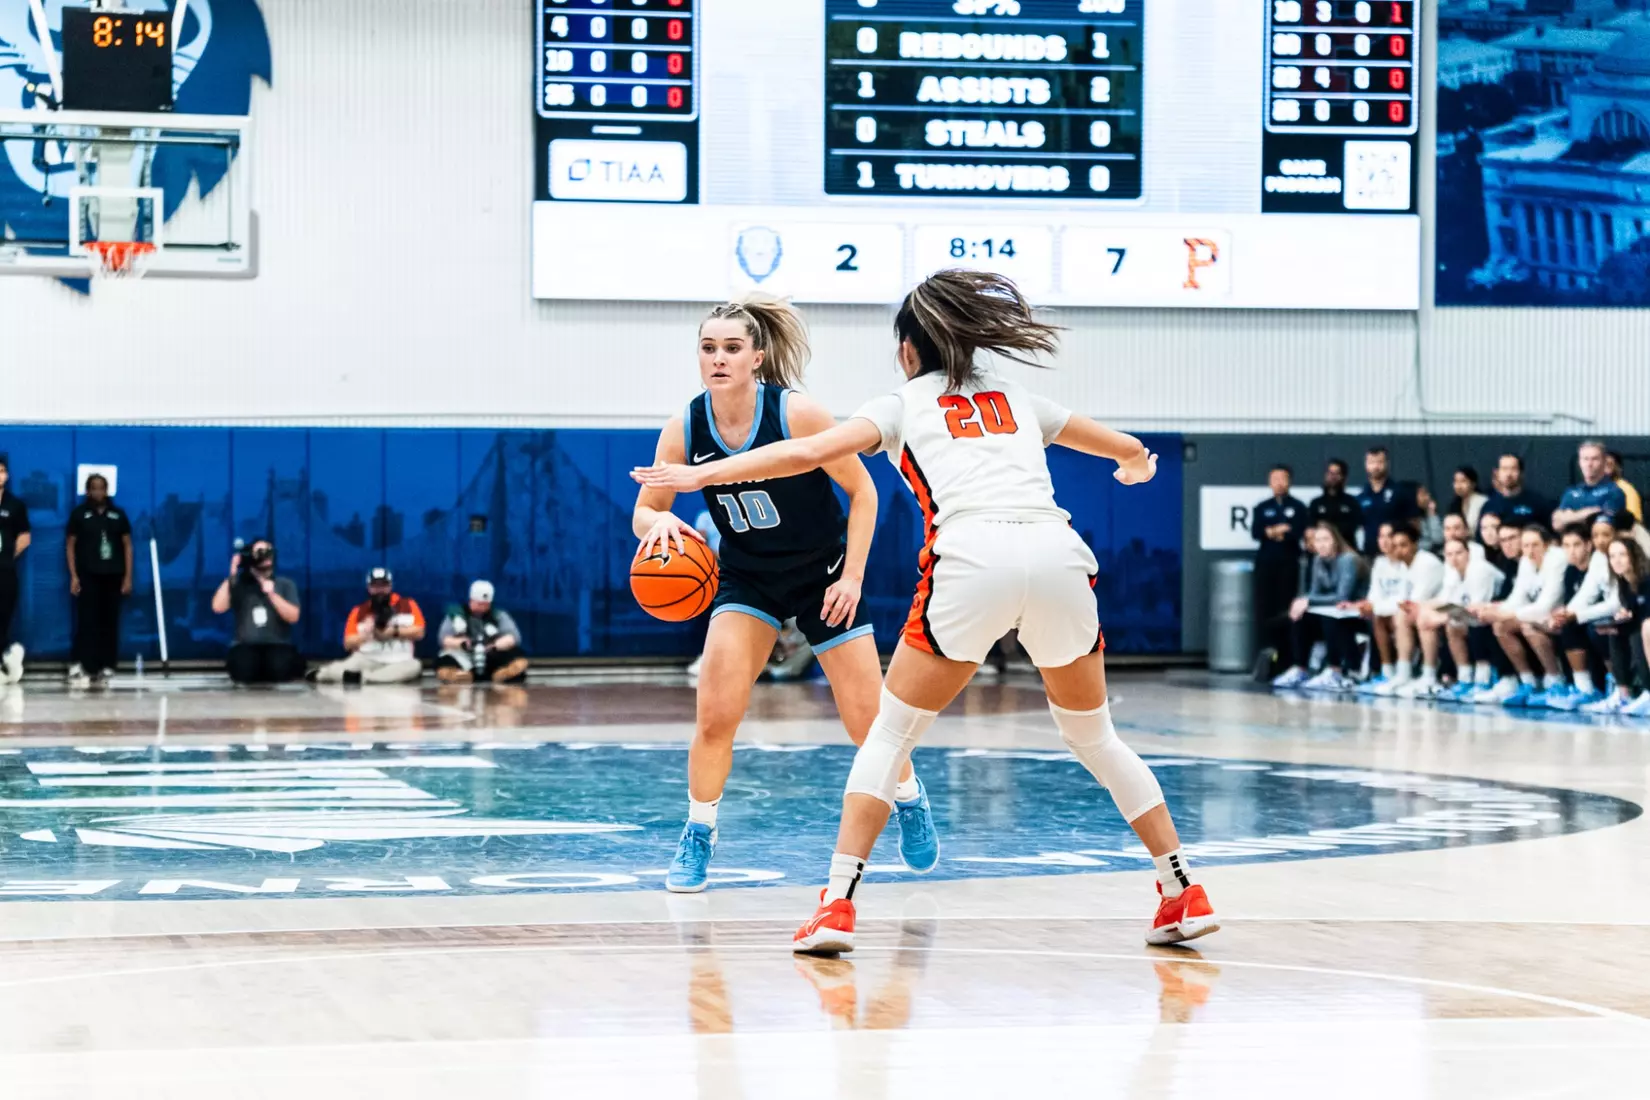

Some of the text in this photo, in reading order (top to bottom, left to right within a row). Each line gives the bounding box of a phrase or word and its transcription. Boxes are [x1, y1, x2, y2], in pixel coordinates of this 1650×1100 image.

[94, 17, 164, 47] 8:14
[591, 17, 605, 38] 0
[632, 19, 647, 38] 0
[668, 20, 682, 39] 0
[857, 28, 1109, 61] 0 REBOUNDS 1
[1390, 36, 1404, 56] 0
[591, 51, 605, 71] 0
[632, 53, 646, 73] 0
[668, 54, 682, 73] 0
[859, 72, 1109, 104] 1 ASSISTS 2
[1390, 69, 1404, 88] 0
[591, 85, 605, 105] 0
[632, 86, 646, 106] 0
[668, 88, 682, 107] 0
[1390, 101, 1405, 121] 0
[857, 117, 1110, 147] 0 STEALS 0
[600, 161, 665, 182] TIAA
[858, 162, 1109, 191] 1 TURNOVERS 0
[836, 244, 858, 271] 2
[950, 238, 1016, 258] 8:14
[1107, 248, 1126, 274] 7
[937, 391, 1019, 439] 20
[716, 490, 781, 533] 10
